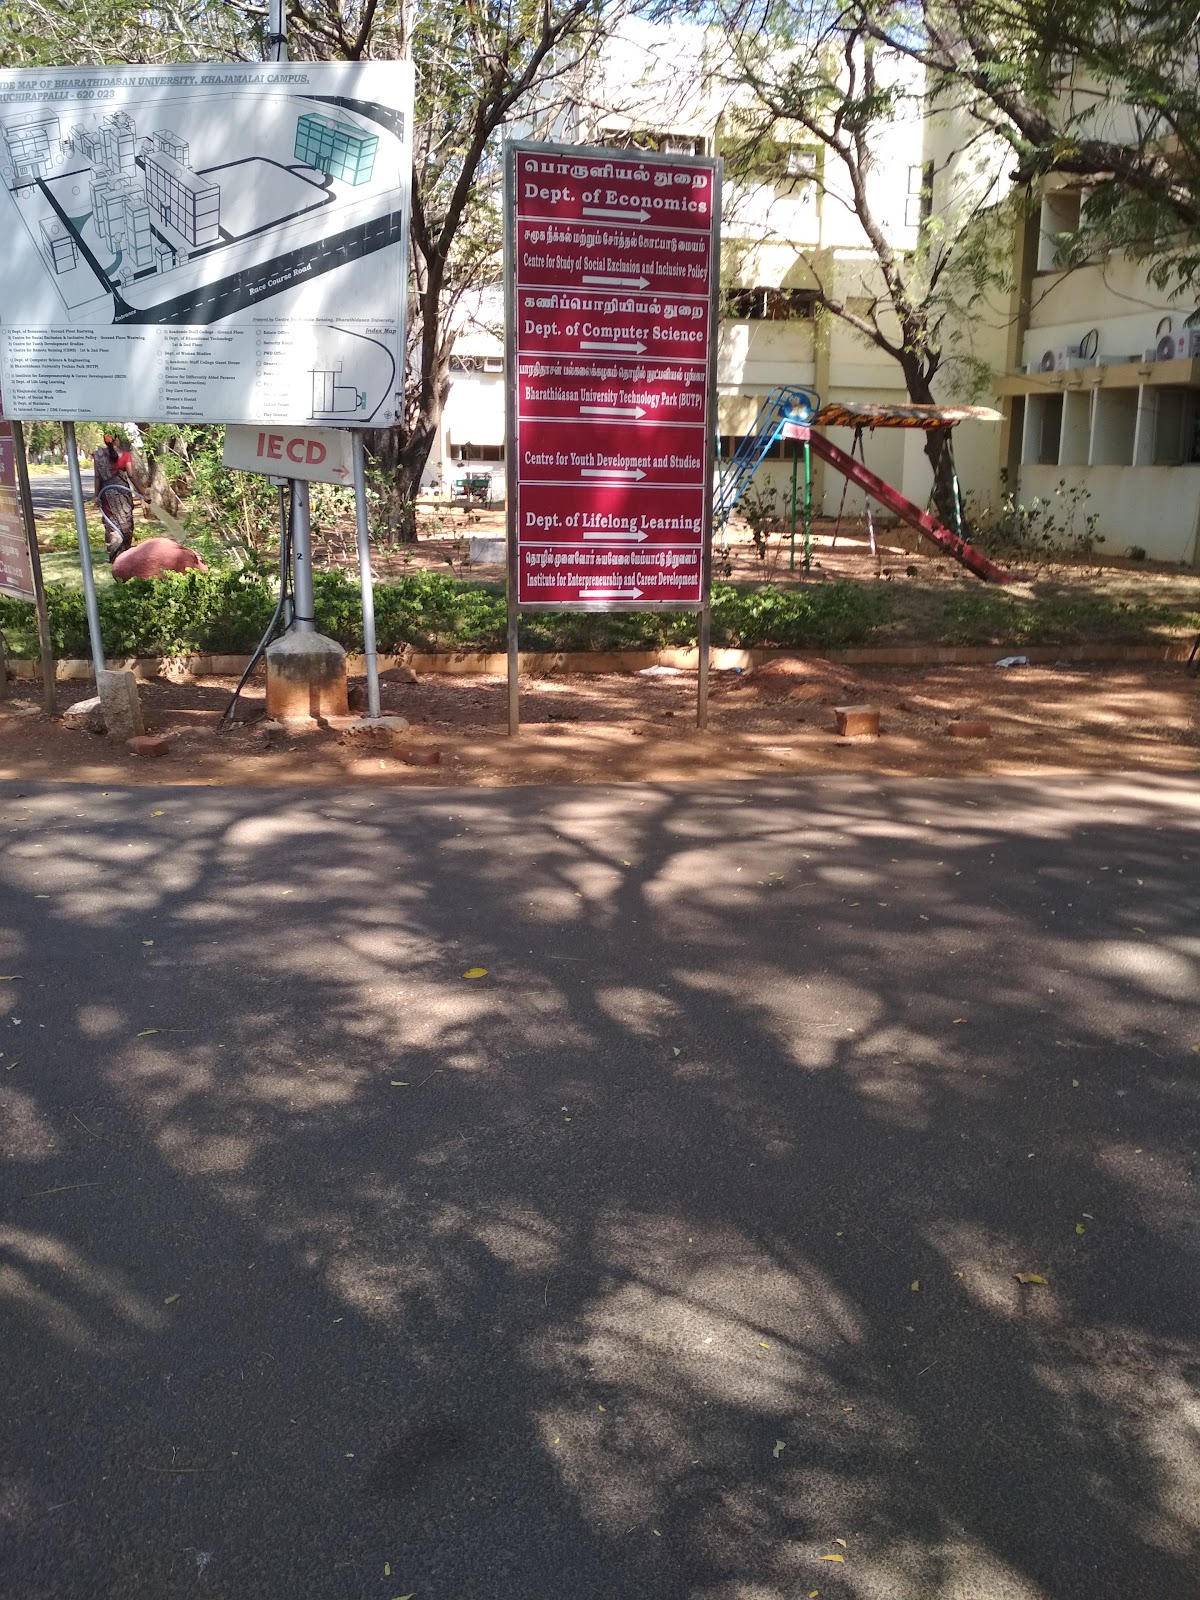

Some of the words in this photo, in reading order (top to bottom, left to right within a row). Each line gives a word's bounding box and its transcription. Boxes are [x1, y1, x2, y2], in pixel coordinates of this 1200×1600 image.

[17, 80, 38, 90] MAP
[40, 79, 52, 89] OF
[54, 77, 135, 89] BHARATHIDASAN
[138, 75, 198, 87] UNIVERSITY,
[200, 74, 265, 85] KHAJAMALAI
[267, 74, 309, 84] CAMPUS,
[77, 90, 94, 100] 620
[97, 90, 115, 98] 023
[525, 159, 650, 181] பொருளியல்
[654, 171, 708, 189] துறை
[525, 184, 576, 204] Dept.
[582, 188, 602, 203] of
[606, 190, 707, 213] Economics
[524, 253, 545, 268] Centre
[546, 254, 557, 269] for
[557, 255, 574, 273] Study
[576, 256, 583, 271] of
[584, 256, 606, 272] Social
[607, 258, 640, 275] Exclusion
[642, 260, 655, 274] and
[656, 261, 687, 277] Inclusive
[687, 264, 709, 282] Policy
[249, 284, 267, 296] Race
[267, 273, 292, 288] Course
[293, 262, 312, 277] Road
[663, 305, 704, 320] துறை
[365, 327, 382, 335] Index
[525, 320, 563, 339] Dept.
[565, 322, 582, 337] of
[582, 324, 649, 342] Computer
[652, 326, 703, 342] Science
[525, 387, 579, 402] Bharathidasan
[580, 388, 618, 406] University
[619, 389, 660, 409] Technology
[661, 392, 678, 406] Park
[678, 392, 702, 410] (BUTP)
[256, 432, 327, 465] IECD
[525, 451, 554, 466] Centre
[556, 452, 568, 466] for
[570, 452, 595, 467] Youth
[597, 453, 651, 470] Development
[652, 455, 668, 468] and
[670, 455, 701, 469] Studies
[526, 512, 562, 531] Dept.
[565, 513, 581, 528] of
[582, 513, 637, 532] Lifelong
[641, 515, 701, 532] Learning
[296, 552, 303, 560] 2
[526, 572, 556, 587] Institute
[557, 572, 567, 587] for
[623, 573, 636, 587] and
[636, 573, 657, 587] Career
[658, 573, 698, 589] Development
